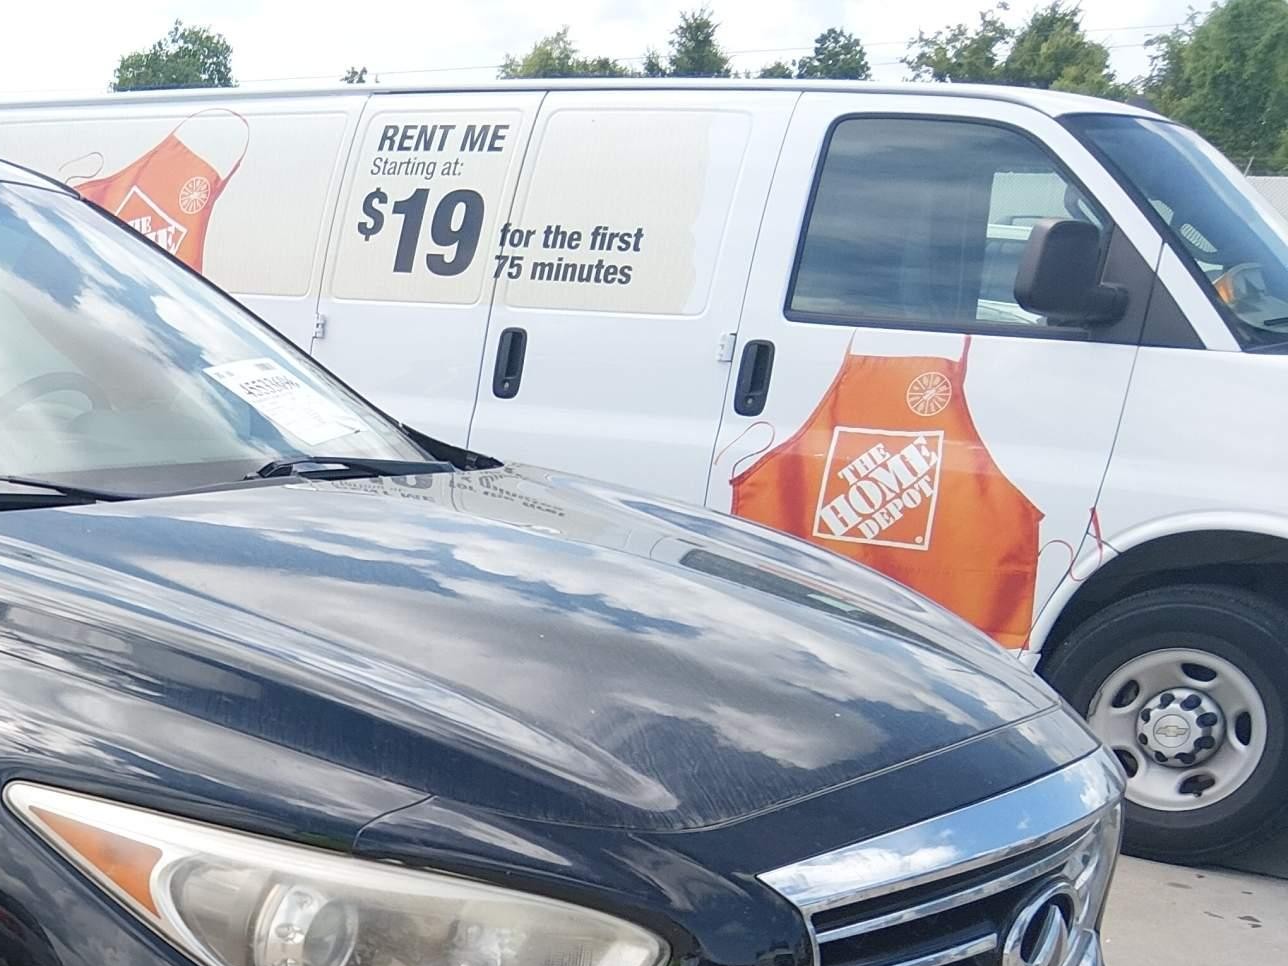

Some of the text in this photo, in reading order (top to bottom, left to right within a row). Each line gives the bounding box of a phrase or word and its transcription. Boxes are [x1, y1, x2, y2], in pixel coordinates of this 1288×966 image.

[377, 124, 510, 152] RENT ME
[370, 157, 464, 180] Starting at:
[357, 187, 485, 276] $19
[499, 223, 644, 252] for the first
[493, 255, 633, 285] 75 minutes
[837, 442, 891, 486] THE
[820, 435, 938, 536] HOME
[857, 475, 934, 540] DEPOT
